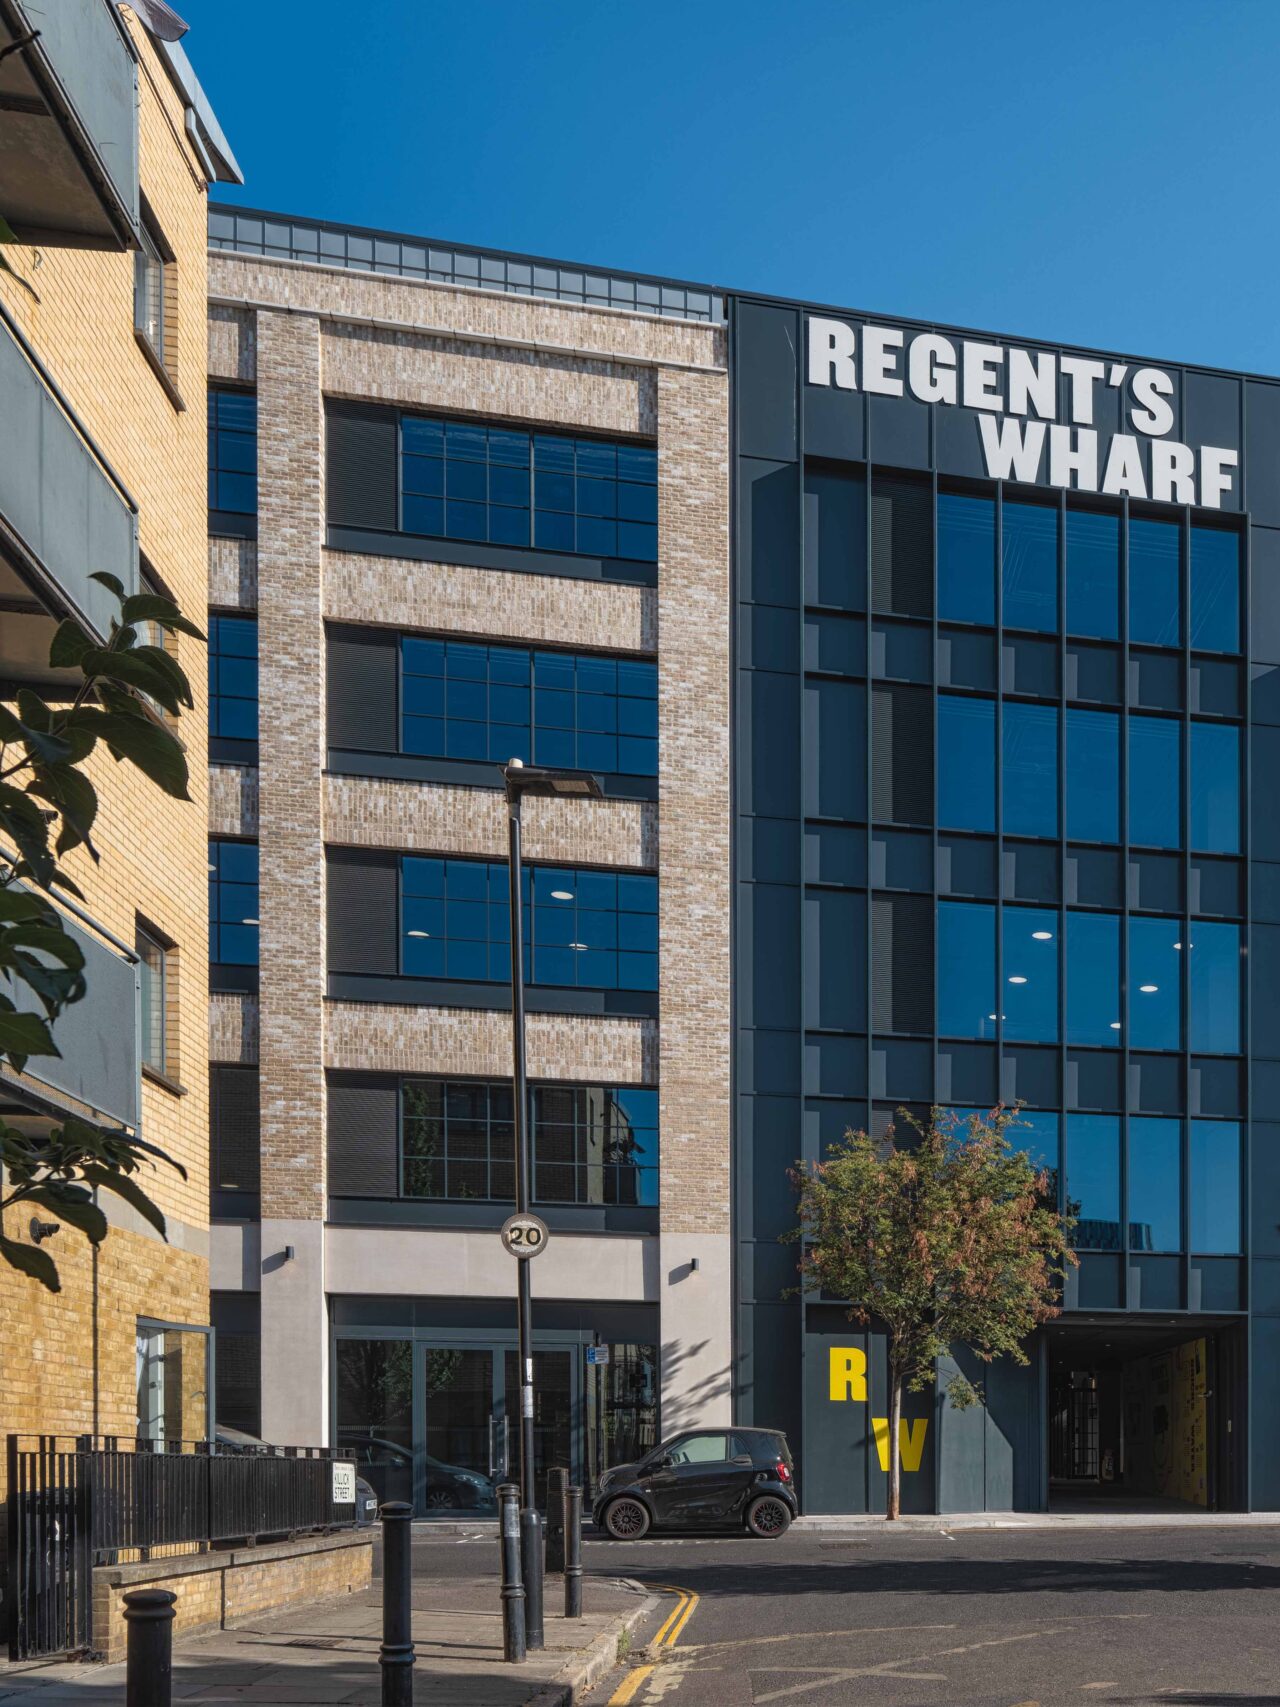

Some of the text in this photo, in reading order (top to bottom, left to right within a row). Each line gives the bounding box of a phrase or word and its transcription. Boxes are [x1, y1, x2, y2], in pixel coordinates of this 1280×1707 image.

[808, 316, 1174, 436] REGENT'S
[977, 413, 1239, 509] WHARF
[509, 1227, 542, 1245] 20
[829, 1347, 868, 1401] R
[871, 1418, 928, 1472] W
[334, 1472, 350, 1486] KILLICK
[334, 1487, 350, 1500] STREET
